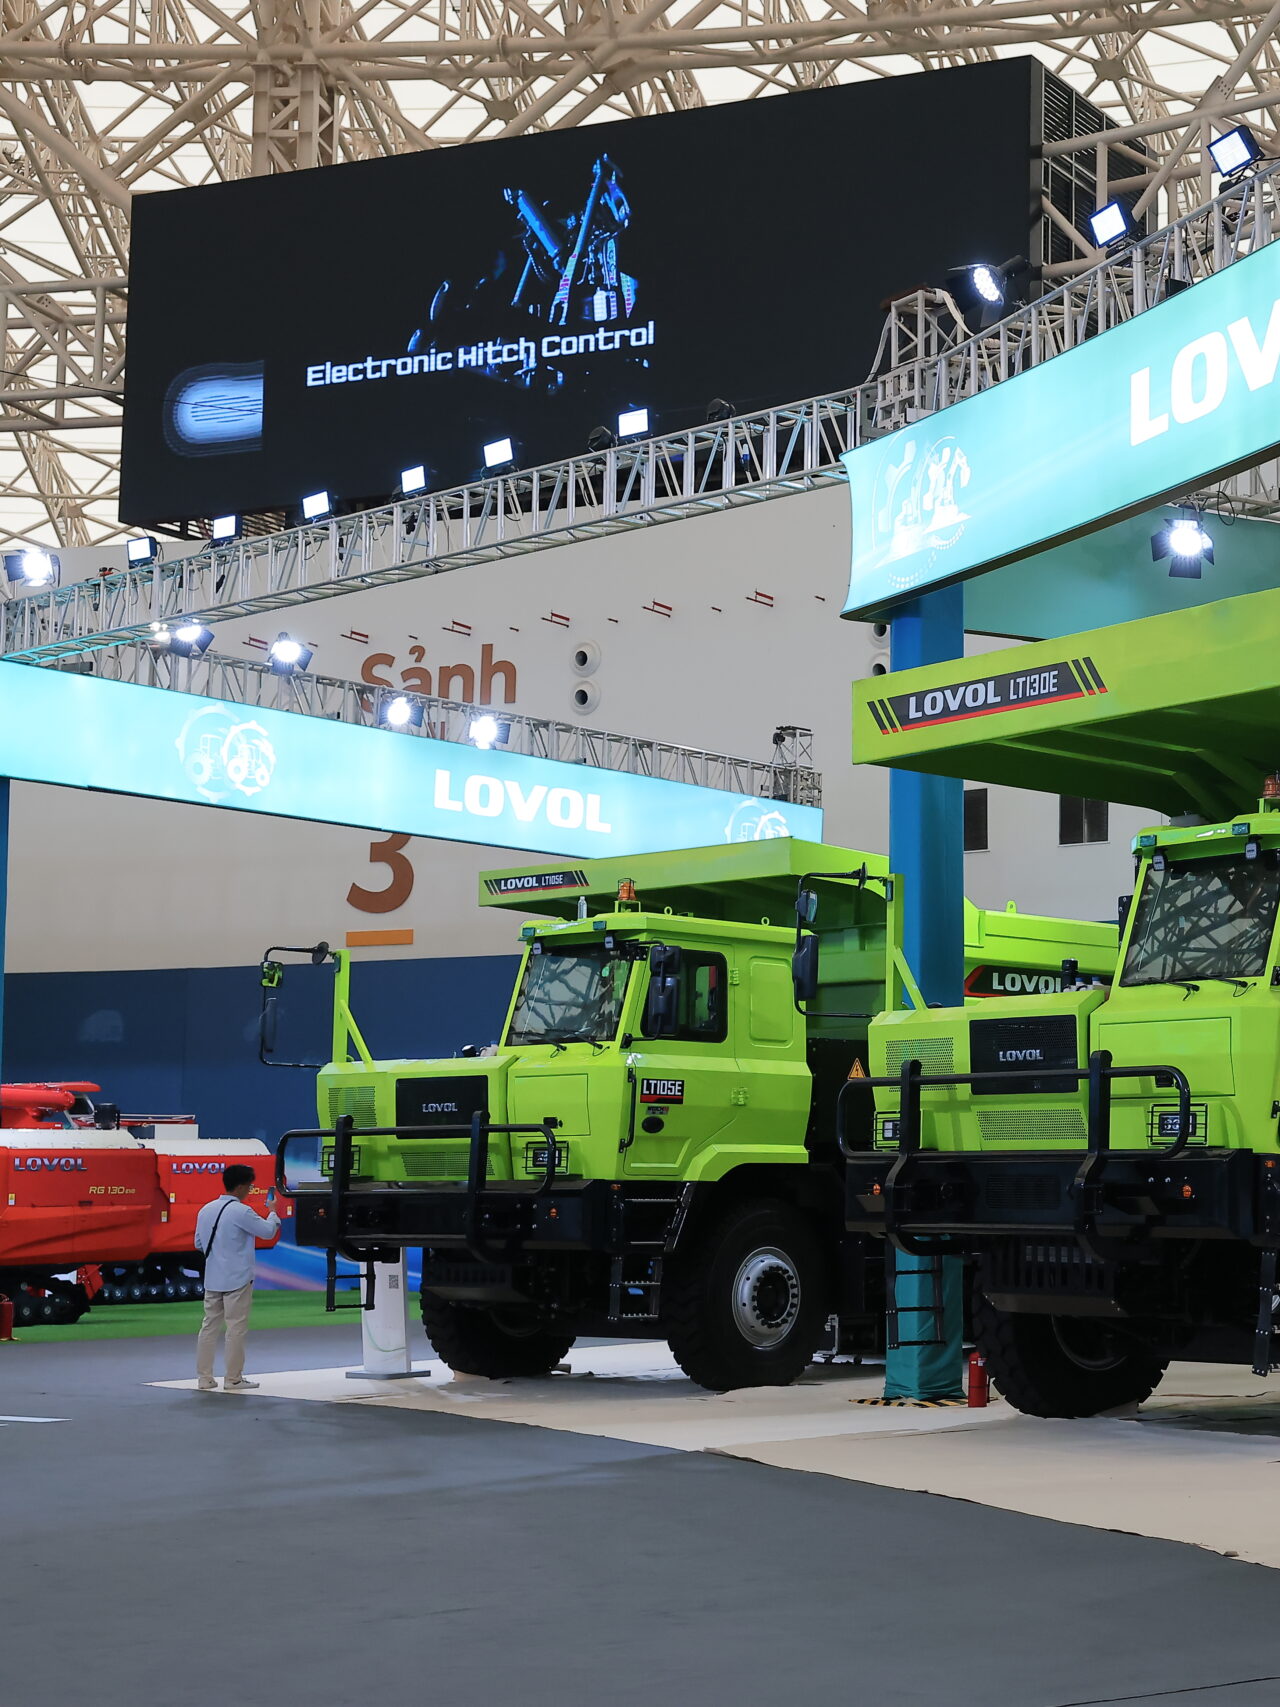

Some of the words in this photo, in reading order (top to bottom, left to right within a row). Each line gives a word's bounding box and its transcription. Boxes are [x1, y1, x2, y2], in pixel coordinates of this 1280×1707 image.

[306, 349, 453, 387] Electronic
[457, 337, 536, 369] Hitch
[541, 321, 655, 358] Control
[908, 680, 1001, 720] LOVOL
[1009, 670, 1058, 701] LT130E
[433, 768, 612, 834] LOVOL
[346, 833, 415, 914] 3
[500, 876, 539, 890] LOVOL
[541, 874, 564, 886] LT105E
[999, 1049, 1044, 1062] LOVOL
[643, 1079, 683, 1096] LT105E
[422, 1102, 458, 1113] LOVOL
[14, 1157, 88, 1172] LOVOL
[89, 1186, 105, 1194] RG
[107, 1186, 125, 1194] 130
